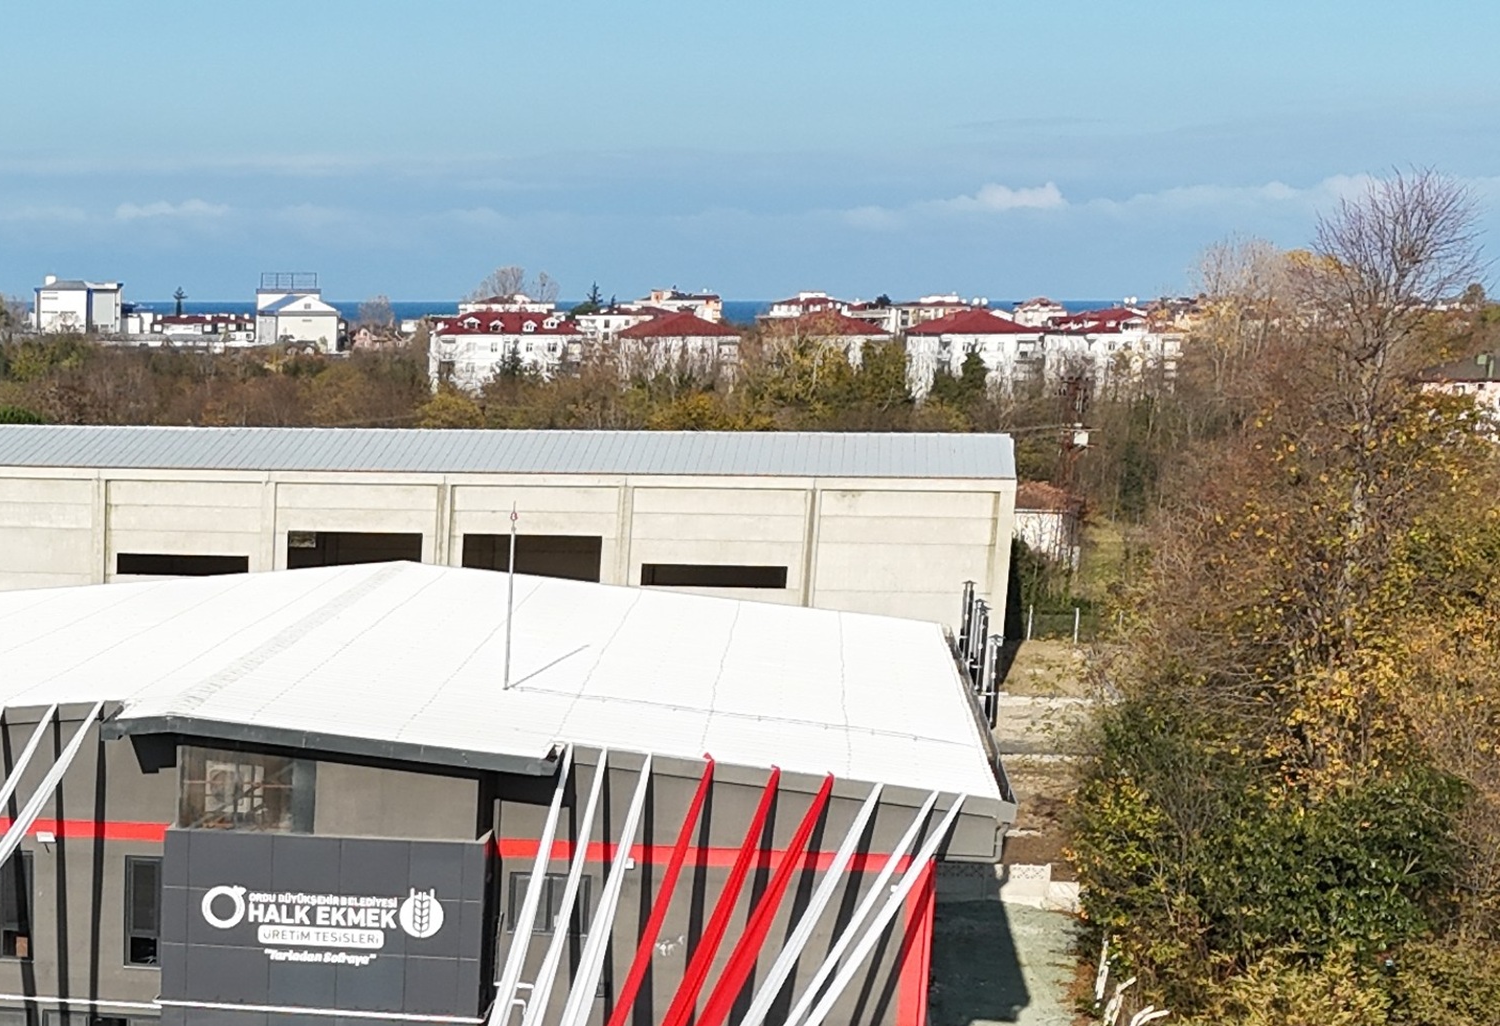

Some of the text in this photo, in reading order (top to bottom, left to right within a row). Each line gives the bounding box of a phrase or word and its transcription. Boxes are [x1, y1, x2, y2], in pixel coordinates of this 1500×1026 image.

[248, 892, 398, 909] ORDU BÜYÜKŞEHİR BELEDİYESİ
[249, 903, 398, 929] HALK EKMEK
